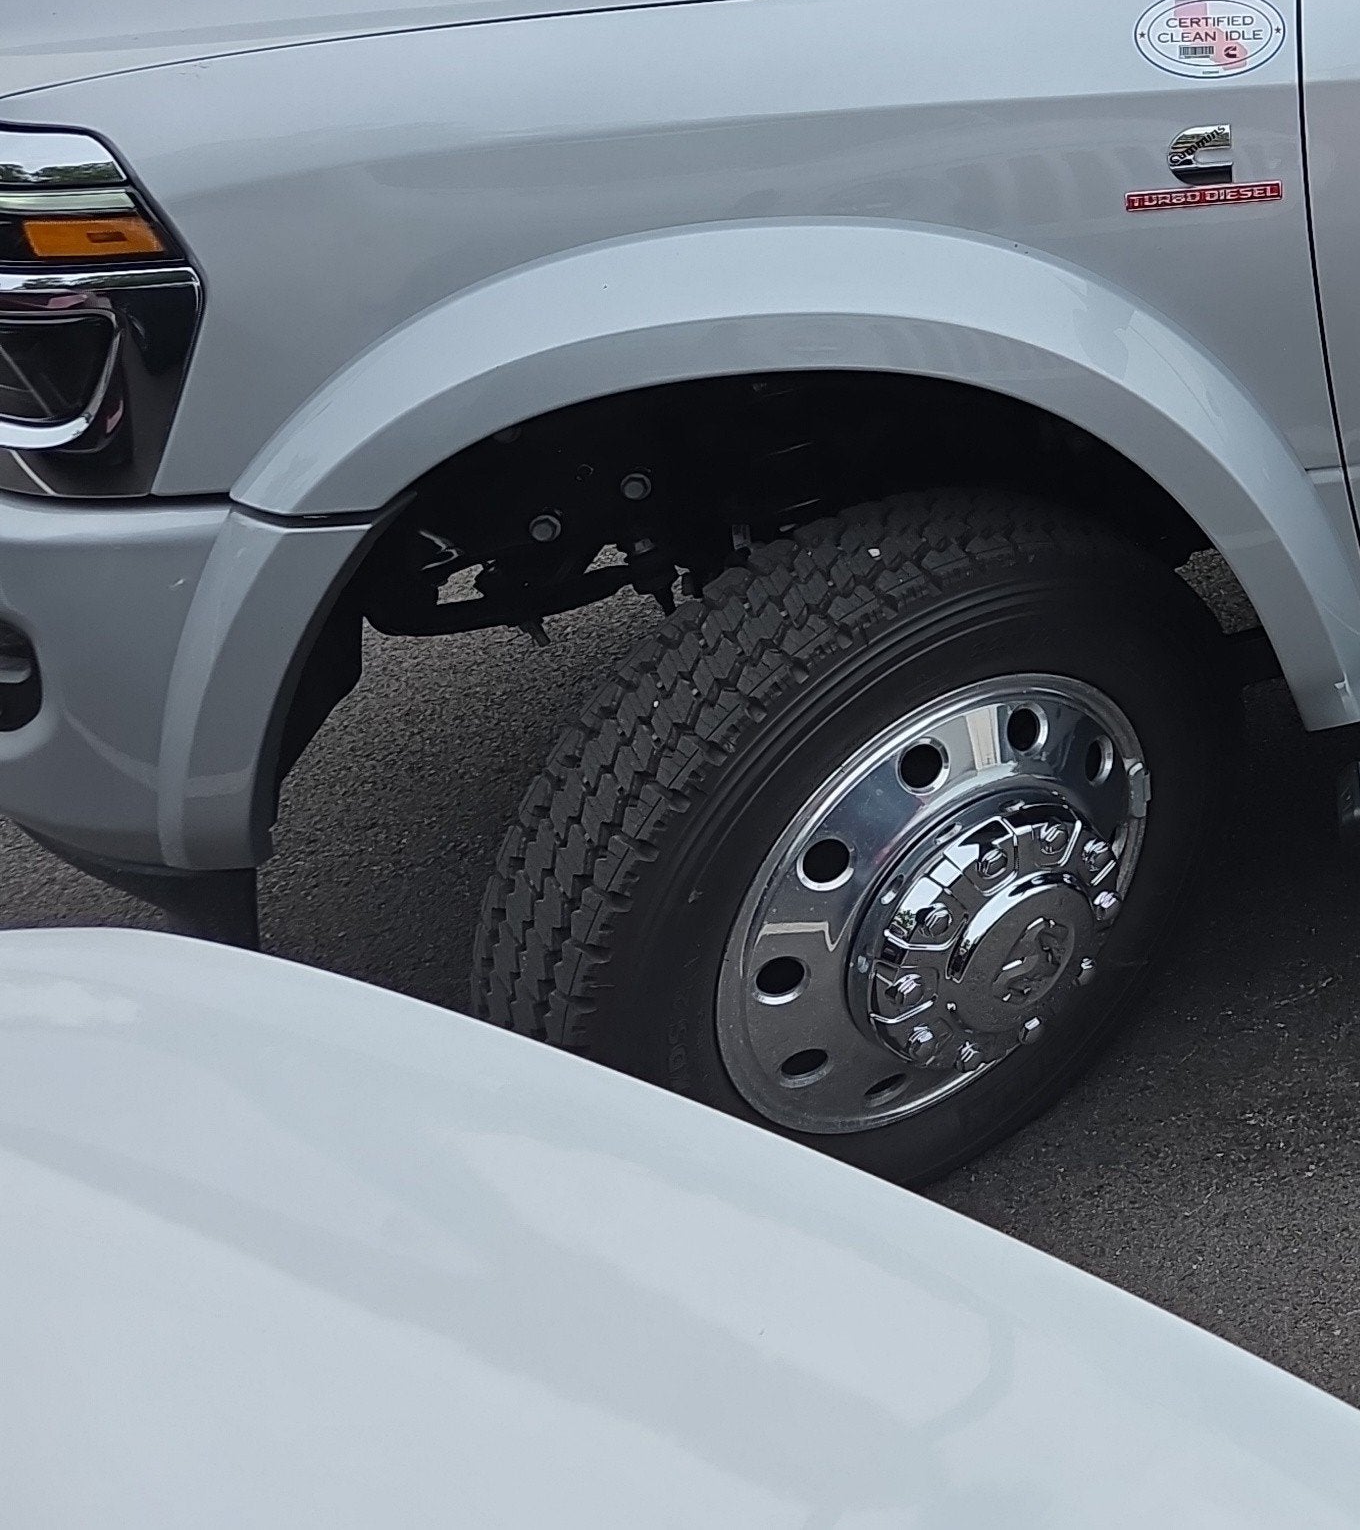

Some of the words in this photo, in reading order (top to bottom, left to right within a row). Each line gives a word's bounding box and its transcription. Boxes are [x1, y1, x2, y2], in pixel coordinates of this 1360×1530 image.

[1165, 15, 1255, 29] CERTIFIED
[1157, 31, 1217, 43] CLEAN
[1225, 29, 1264, 42] IDLE
[1168, 124, 1226, 166] Cummins
[1129, 191, 1200, 208] TURBO
[1205, 184, 1280, 203] DIESEL
